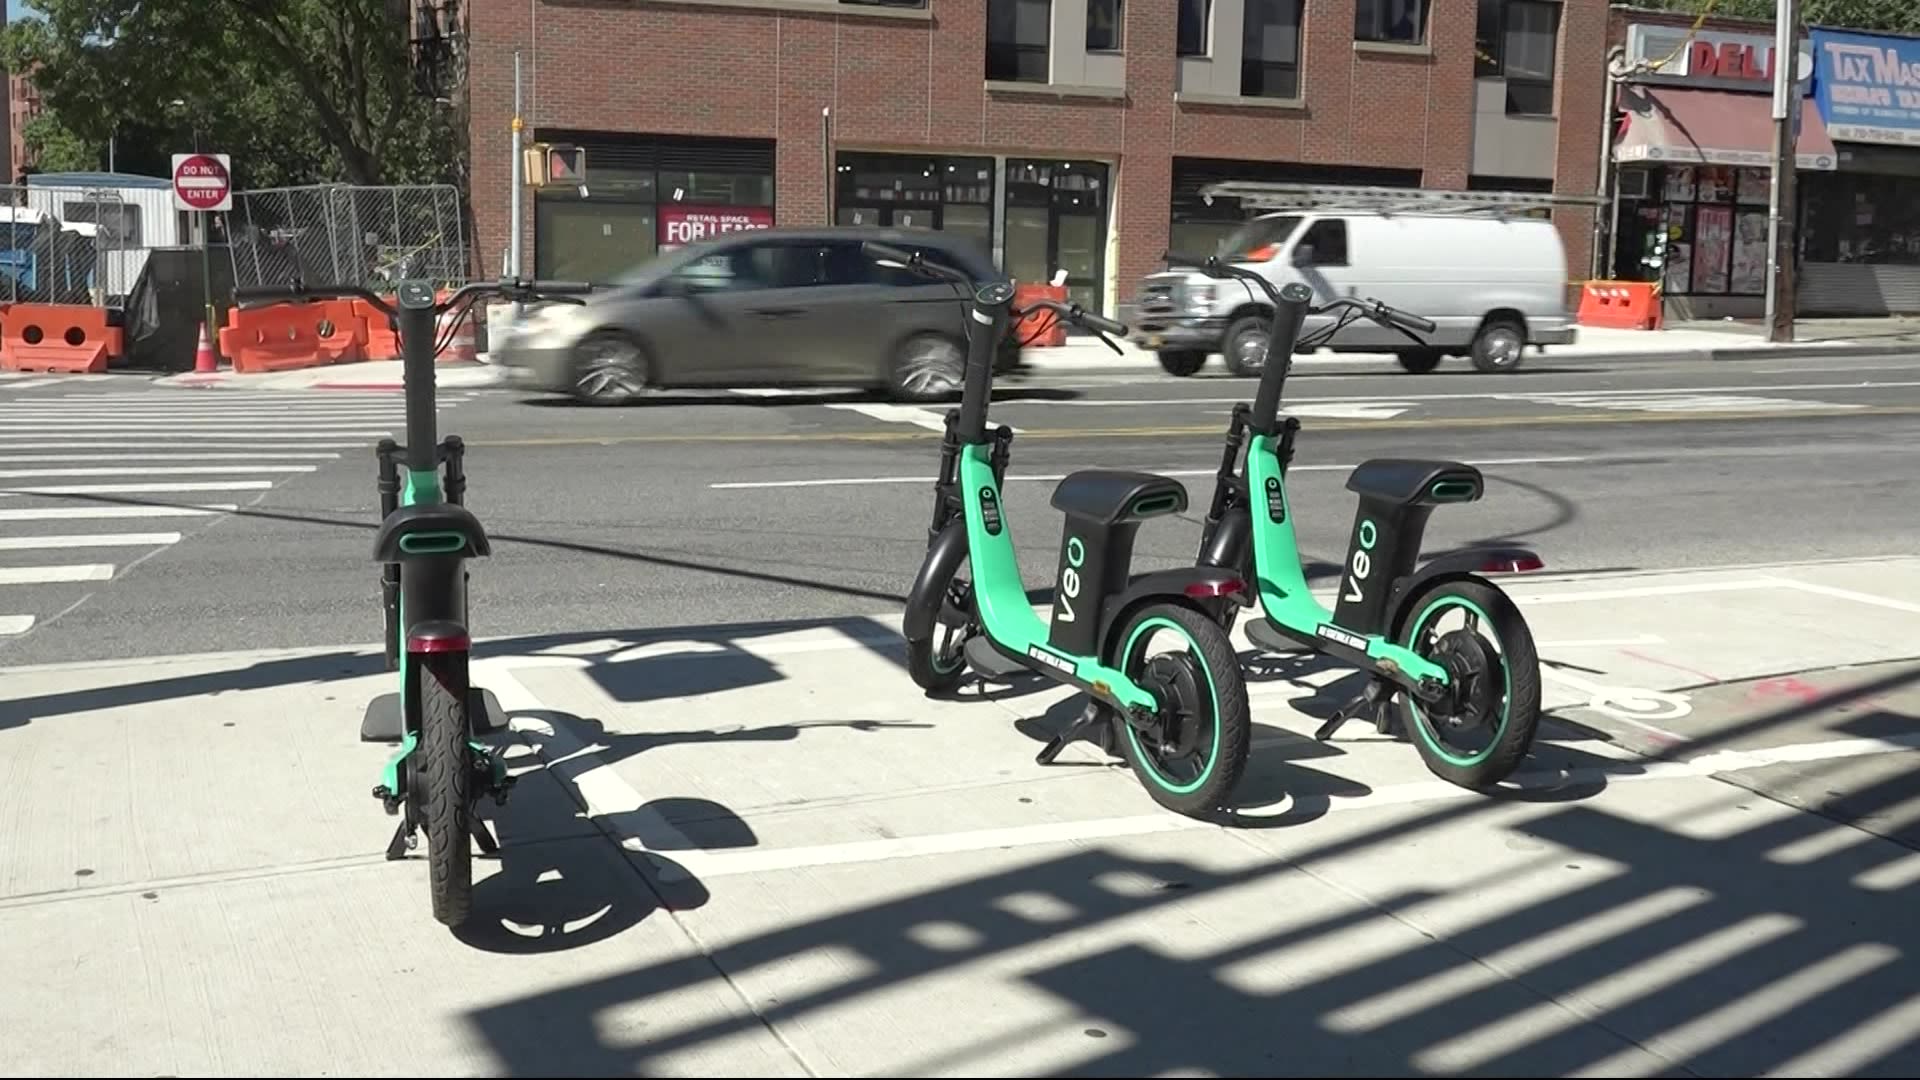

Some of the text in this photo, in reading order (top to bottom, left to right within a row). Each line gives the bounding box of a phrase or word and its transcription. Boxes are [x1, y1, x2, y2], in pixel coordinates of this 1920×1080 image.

[1691, 41, 1775, 81] DELI
[1824, 42, 1872, 83] TAX
[183, 166, 219, 175] DO NOT
[187, 190, 219, 200] ENTER
[667, 221, 705, 243] FOR
[686, 214, 749, 224] RETAIL SPACE
[1344, 519, 1377, 602] veo
[1057, 537, 1084, 622] veo
